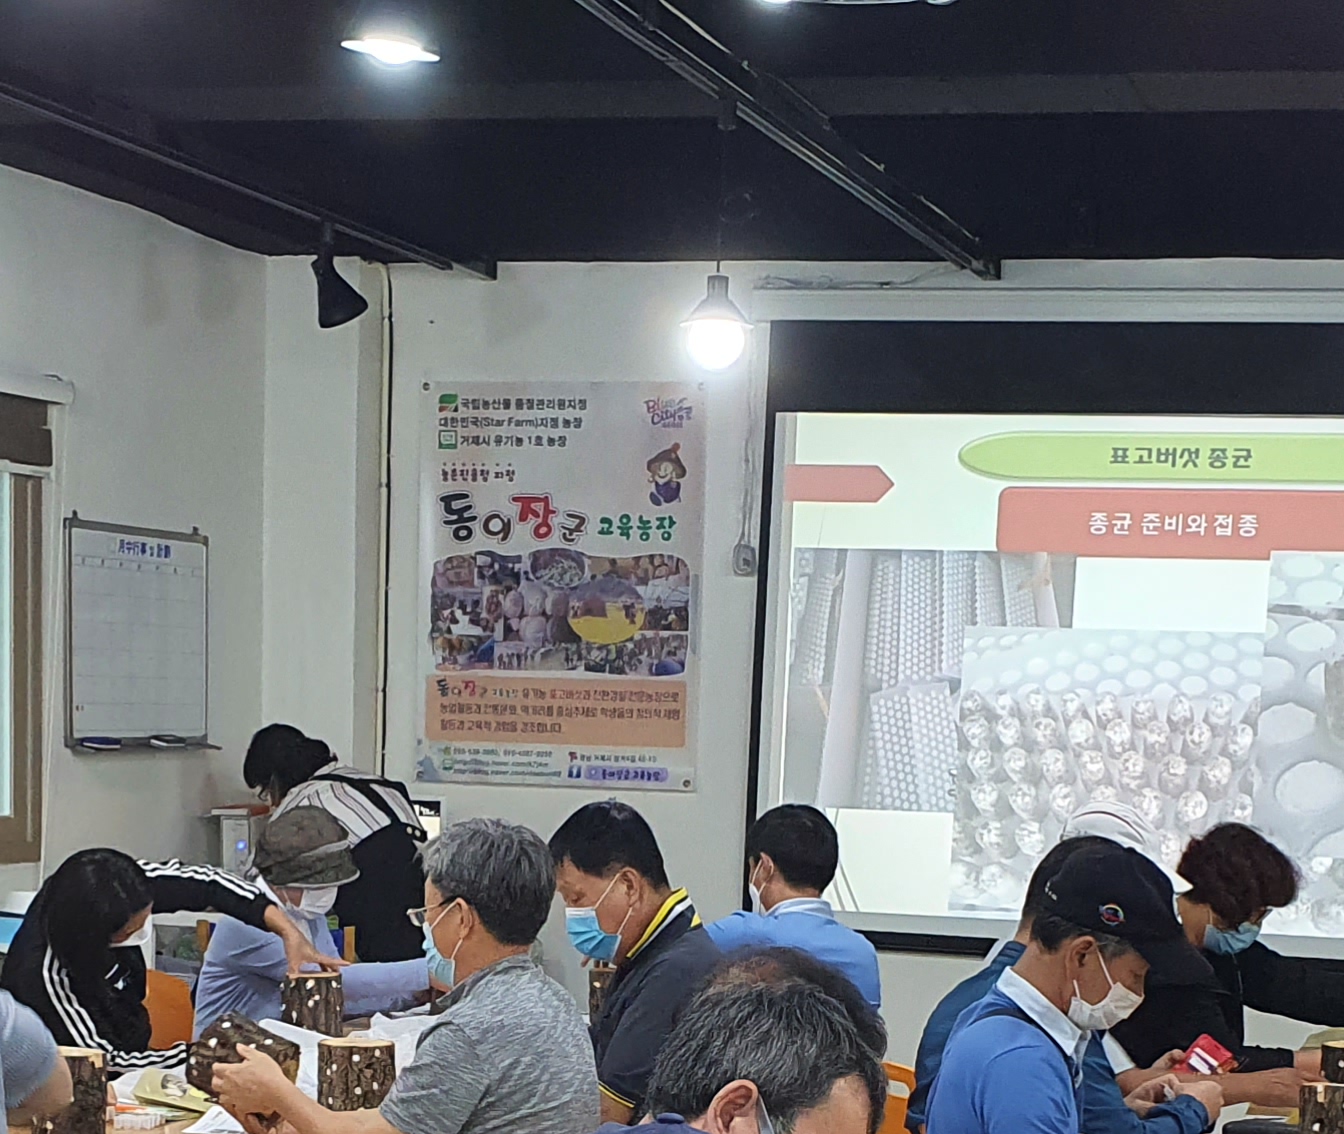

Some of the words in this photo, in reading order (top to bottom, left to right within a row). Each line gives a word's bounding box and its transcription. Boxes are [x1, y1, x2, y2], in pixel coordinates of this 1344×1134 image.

[461, 398, 512, 411] 국립농산물
[562, 417, 583, 429] 농장
[460, 435, 491, 447] 거제시
[494, 435, 524, 447] 유기농
[528, 436, 544, 447] 1호
[547, 435, 568, 447] 농장
[1109, 445, 1200, 469] 표고버섯
[1208, 446, 1253, 469] 종균
[438, 491, 588, 543] 동이장군
[597, 513, 677, 542] 교육농장
[1088, 512, 1131, 536] 종균
[1140, 512, 1208, 537] 준비와
[1212, 513, 1259, 537] 접종
